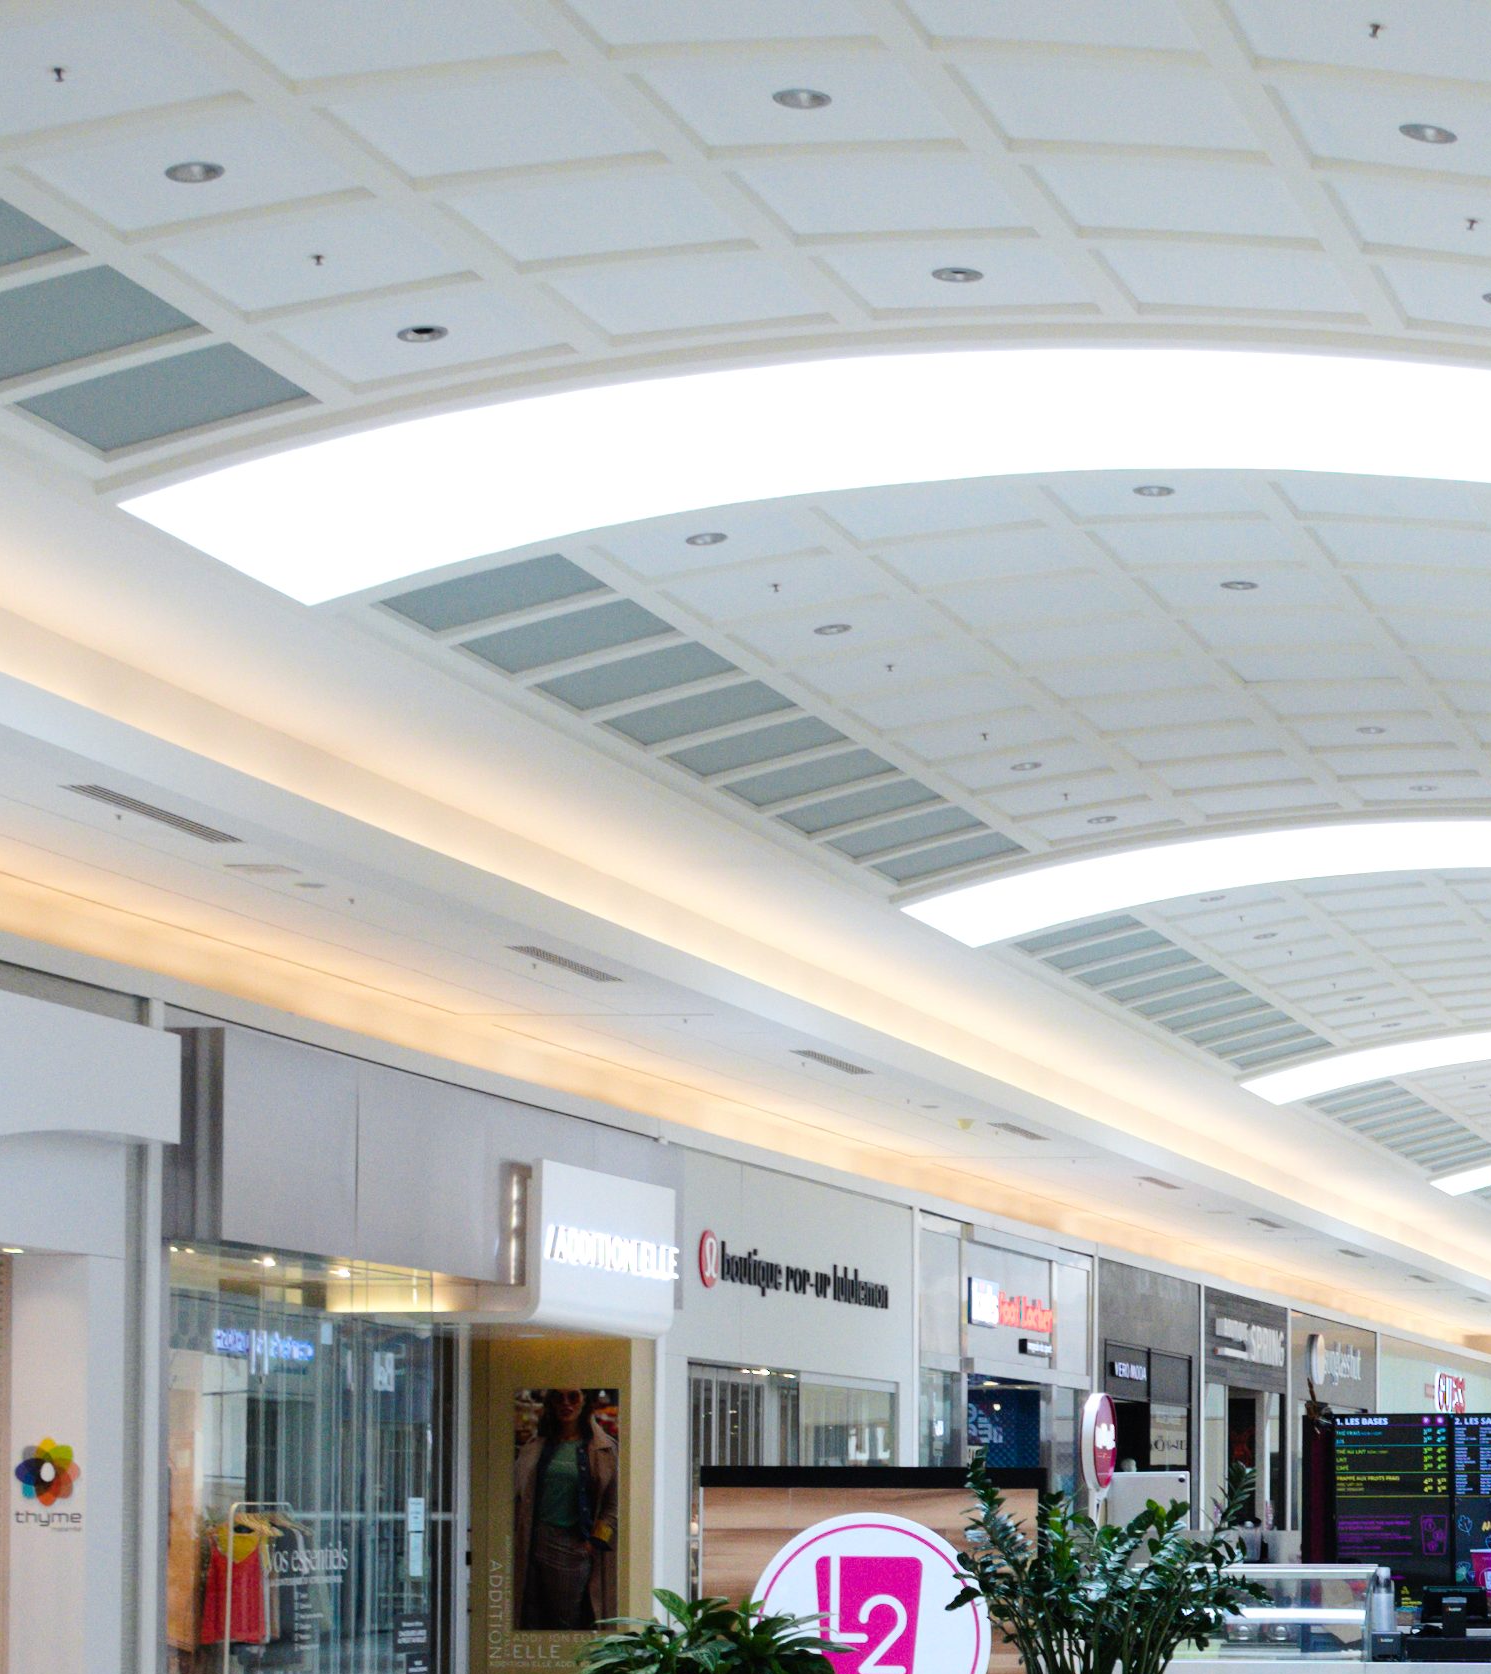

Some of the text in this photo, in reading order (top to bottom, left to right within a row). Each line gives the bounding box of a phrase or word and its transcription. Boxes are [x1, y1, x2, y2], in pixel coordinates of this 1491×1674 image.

[720, 1240, 783, 1297] boutique
[833, 1263, 889, 1310] lululemon
[1114, 1361, 1147, 1382] VERO MODA
[1344, 1417, 1360, 1426] LES
[1361, 1417, 1389, 1426] BASES
[1463, 1417, 1479, 1426] LES
[14, 1510, 83, 1527] thyme
[290, 1541, 349, 1575] essentiels
[488, 1560, 504, 1660] ADDITION
[512, 1644, 561, 1659] ELLE
